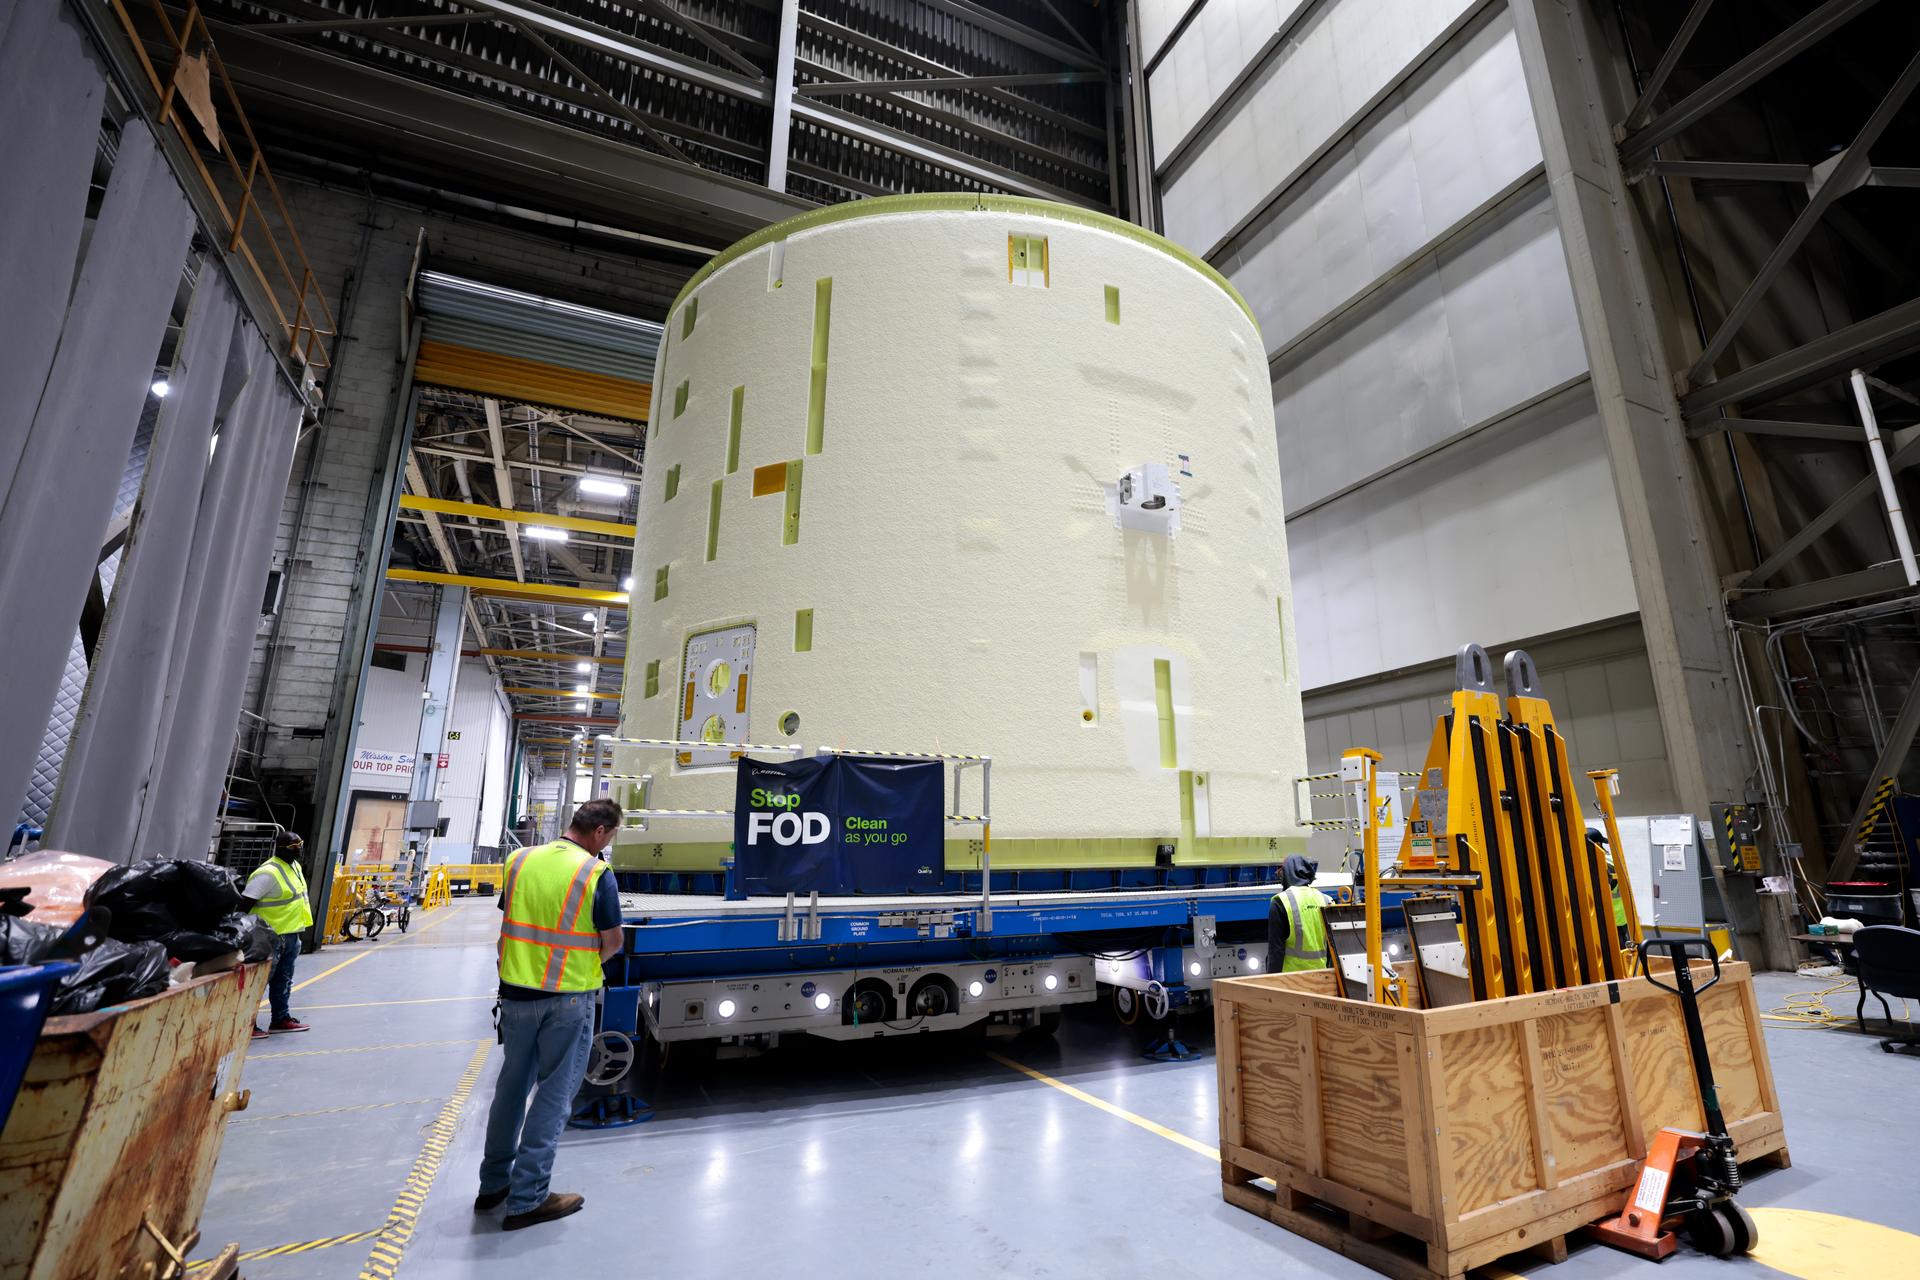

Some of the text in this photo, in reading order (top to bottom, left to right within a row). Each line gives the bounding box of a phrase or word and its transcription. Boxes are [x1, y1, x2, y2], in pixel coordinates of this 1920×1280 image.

[360, 751, 393, 760] Mission
[352, 760, 373, 770] OUR
[376, 762, 393, 771] TOP
[750, 788, 801, 812] Stop
[747, 811, 831, 846] FOD
[845, 816, 888, 830] Clean
[844, 833, 908, 846] as you go
[1313, 1001, 1396, 1022] REMOVE BOLTS BEFORE
[1338, 1014, 1388, 1029] LIFTING LID
